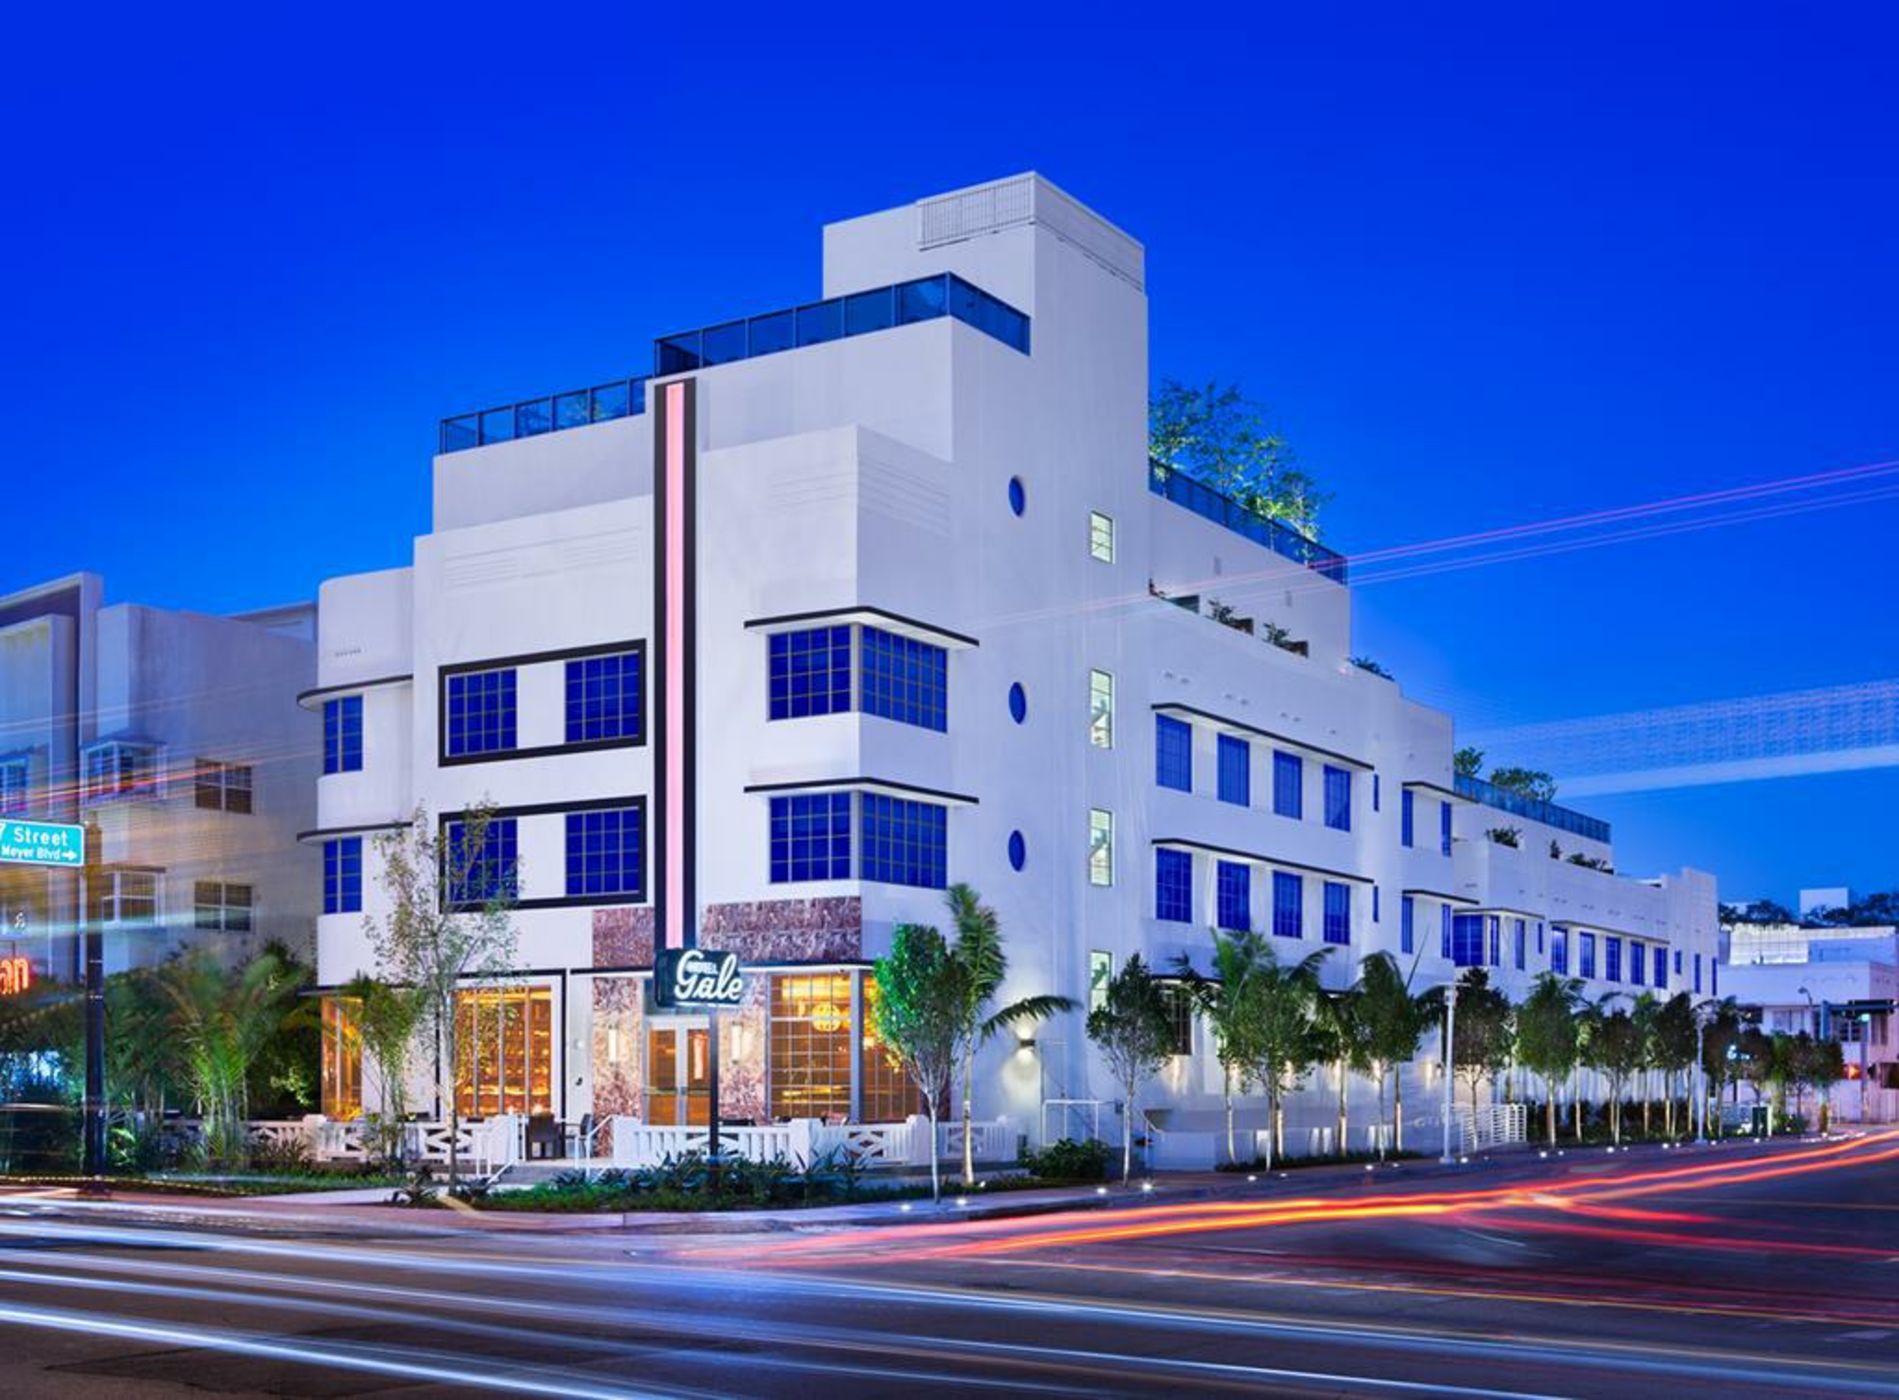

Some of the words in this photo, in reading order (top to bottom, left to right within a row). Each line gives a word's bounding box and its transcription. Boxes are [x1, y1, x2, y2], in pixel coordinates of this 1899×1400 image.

[14, 826, 68, 847] Street
[36, 847, 61, 861] Blvd
[674, 949, 743, 1001] Gale
